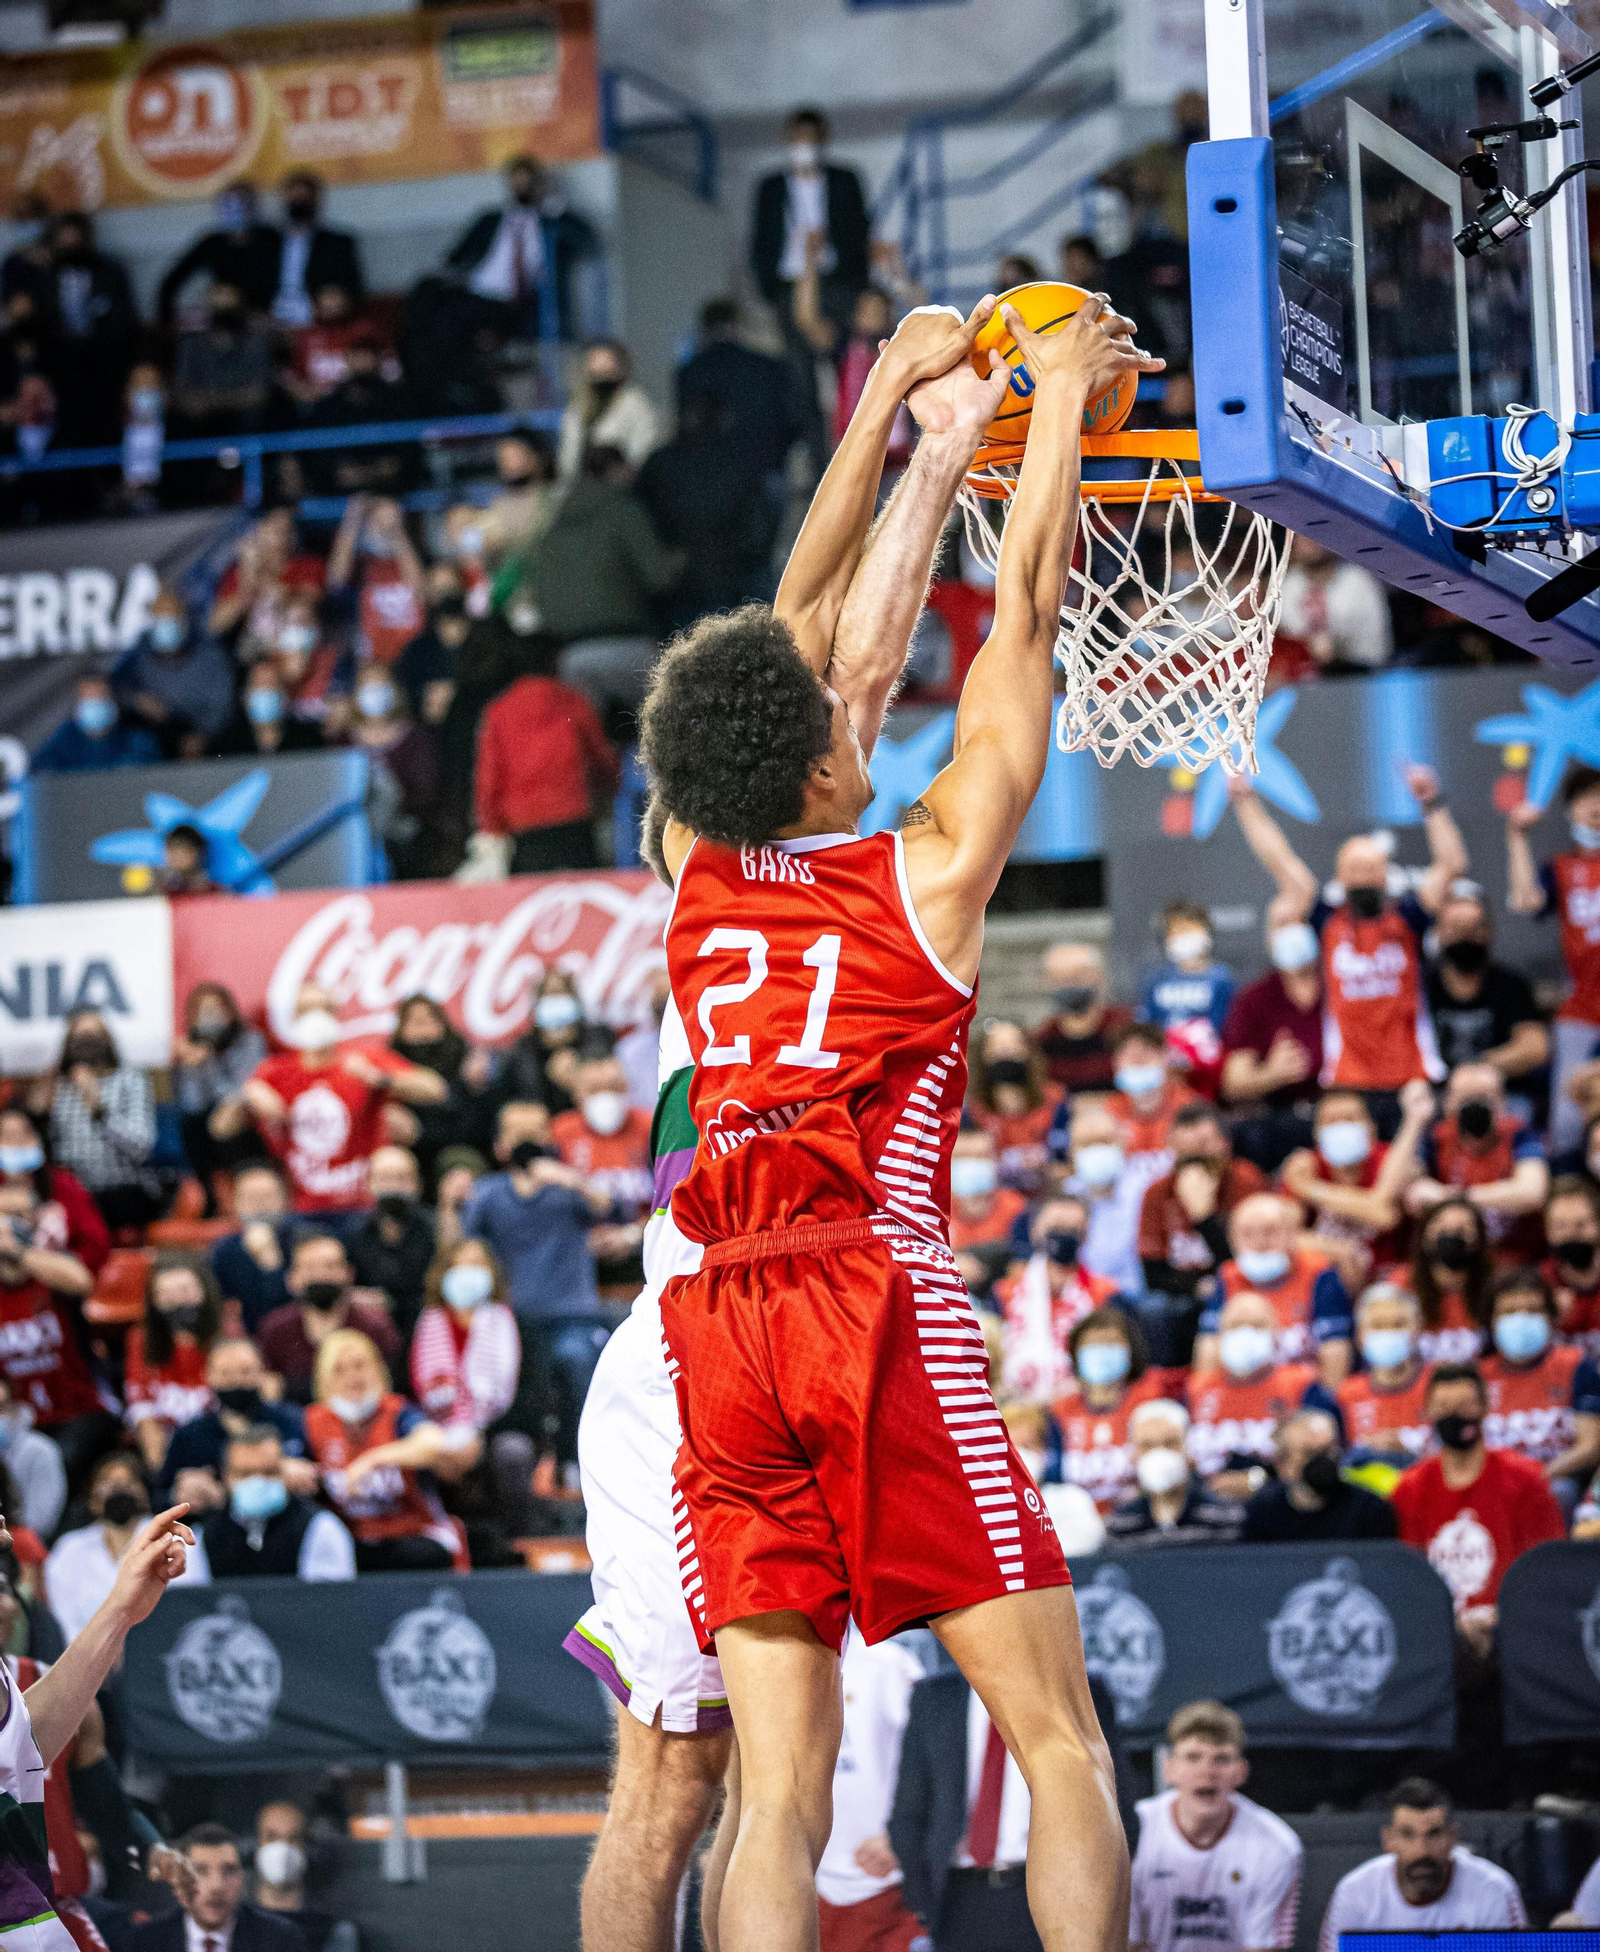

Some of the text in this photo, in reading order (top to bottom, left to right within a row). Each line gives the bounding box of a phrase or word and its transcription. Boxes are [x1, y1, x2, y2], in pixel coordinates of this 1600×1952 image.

[1289, 300, 1336, 347] BASKETBALL
[1290, 324, 1342, 376] CHAMPIONS
[1291, 350, 1320, 385] LEAGUE
[697, 928, 841, 1069] 21
